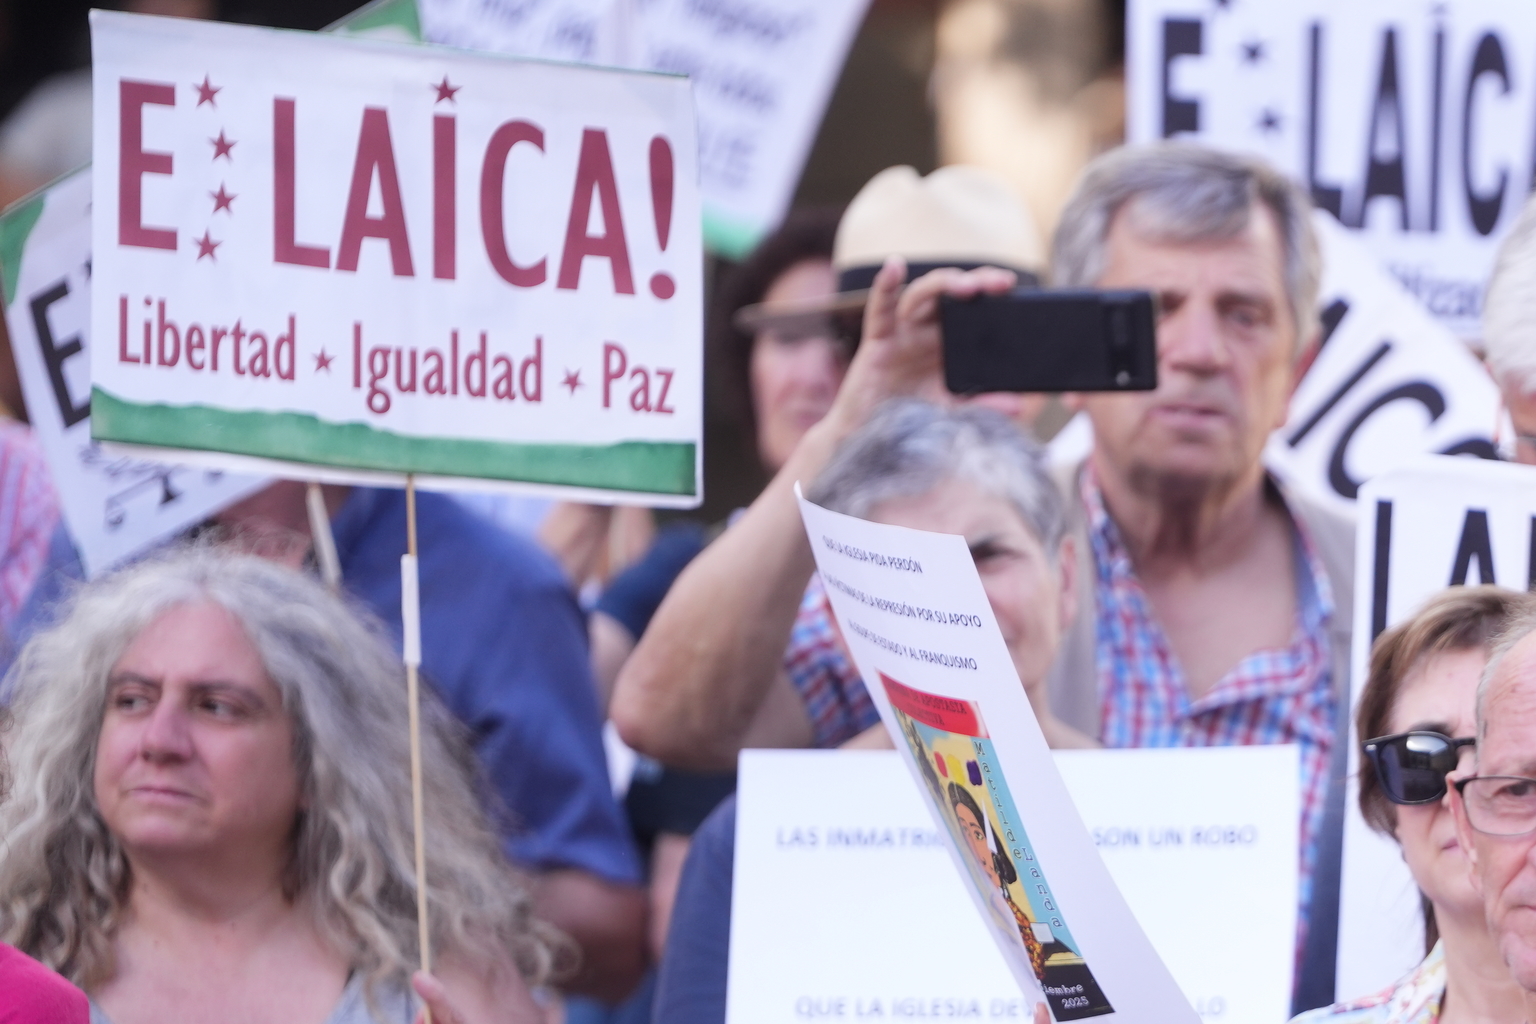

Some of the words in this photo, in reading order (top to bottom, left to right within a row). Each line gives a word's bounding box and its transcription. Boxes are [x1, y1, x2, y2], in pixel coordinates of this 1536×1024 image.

[117, 77, 179, 252] E
[118, 295, 297, 381] Libertad
[352, 321, 544, 415] Igualdad
[602, 342, 676, 415] Paz
[869, 551, 888, 567] PIDA
[887, 556, 923, 574] PERDÓN
[916, 607, 935, 621] POR
[935, 610, 947, 624] SU
[949, 612, 982, 628] APOYO
[909, 647, 919, 660] AL
[919, 649, 977, 670] FRANQUISMO
[776, 825, 818, 850] LAS
[1148, 822, 1181, 848] UN
[1189, 822, 1259, 848] ROBO
[1022, 847, 1063, 929] Landa
[795, 996, 847, 1021] QUE
[855, 997, 884, 1018] LA
[892, 996, 983, 1018] IGLESIA
[1061, 995, 1090, 1010] 2025
